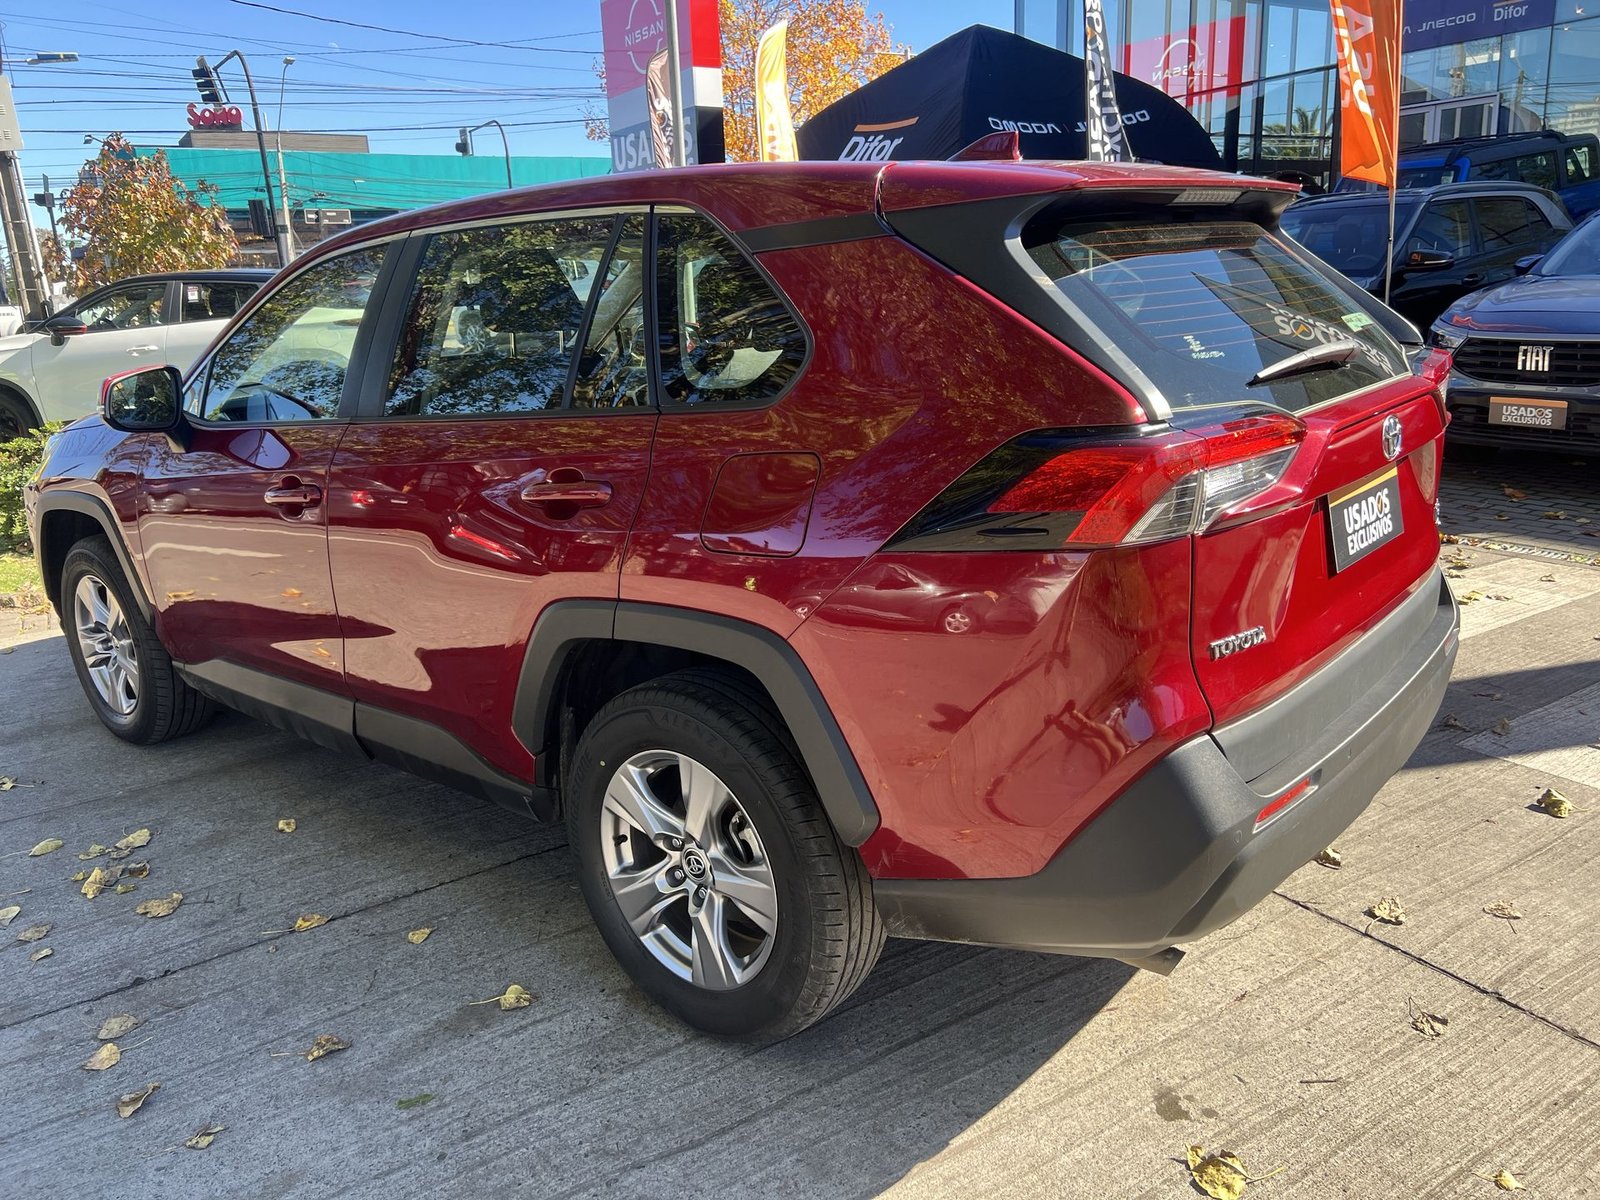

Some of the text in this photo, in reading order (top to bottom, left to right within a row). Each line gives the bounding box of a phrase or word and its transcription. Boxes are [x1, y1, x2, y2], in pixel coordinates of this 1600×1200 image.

[1417, 12, 1477, 32] JAECOO
[1494, 5, 1529, 21] Difor
[624, 20, 664, 47] NISSAN
[837, 134, 904, 161] Difor
[1517, 345, 1554, 372] FIAT
[1501, 415, 1552, 426] EXCLUSIVOS
[1502, 405, 1552, 418] USADOS
[1343, 488, 1390, 534] USADOS
[1347, 513, 1393, 556] EXCLUSIVOS
[1208, 626, 1267, 661] TOYOTA
